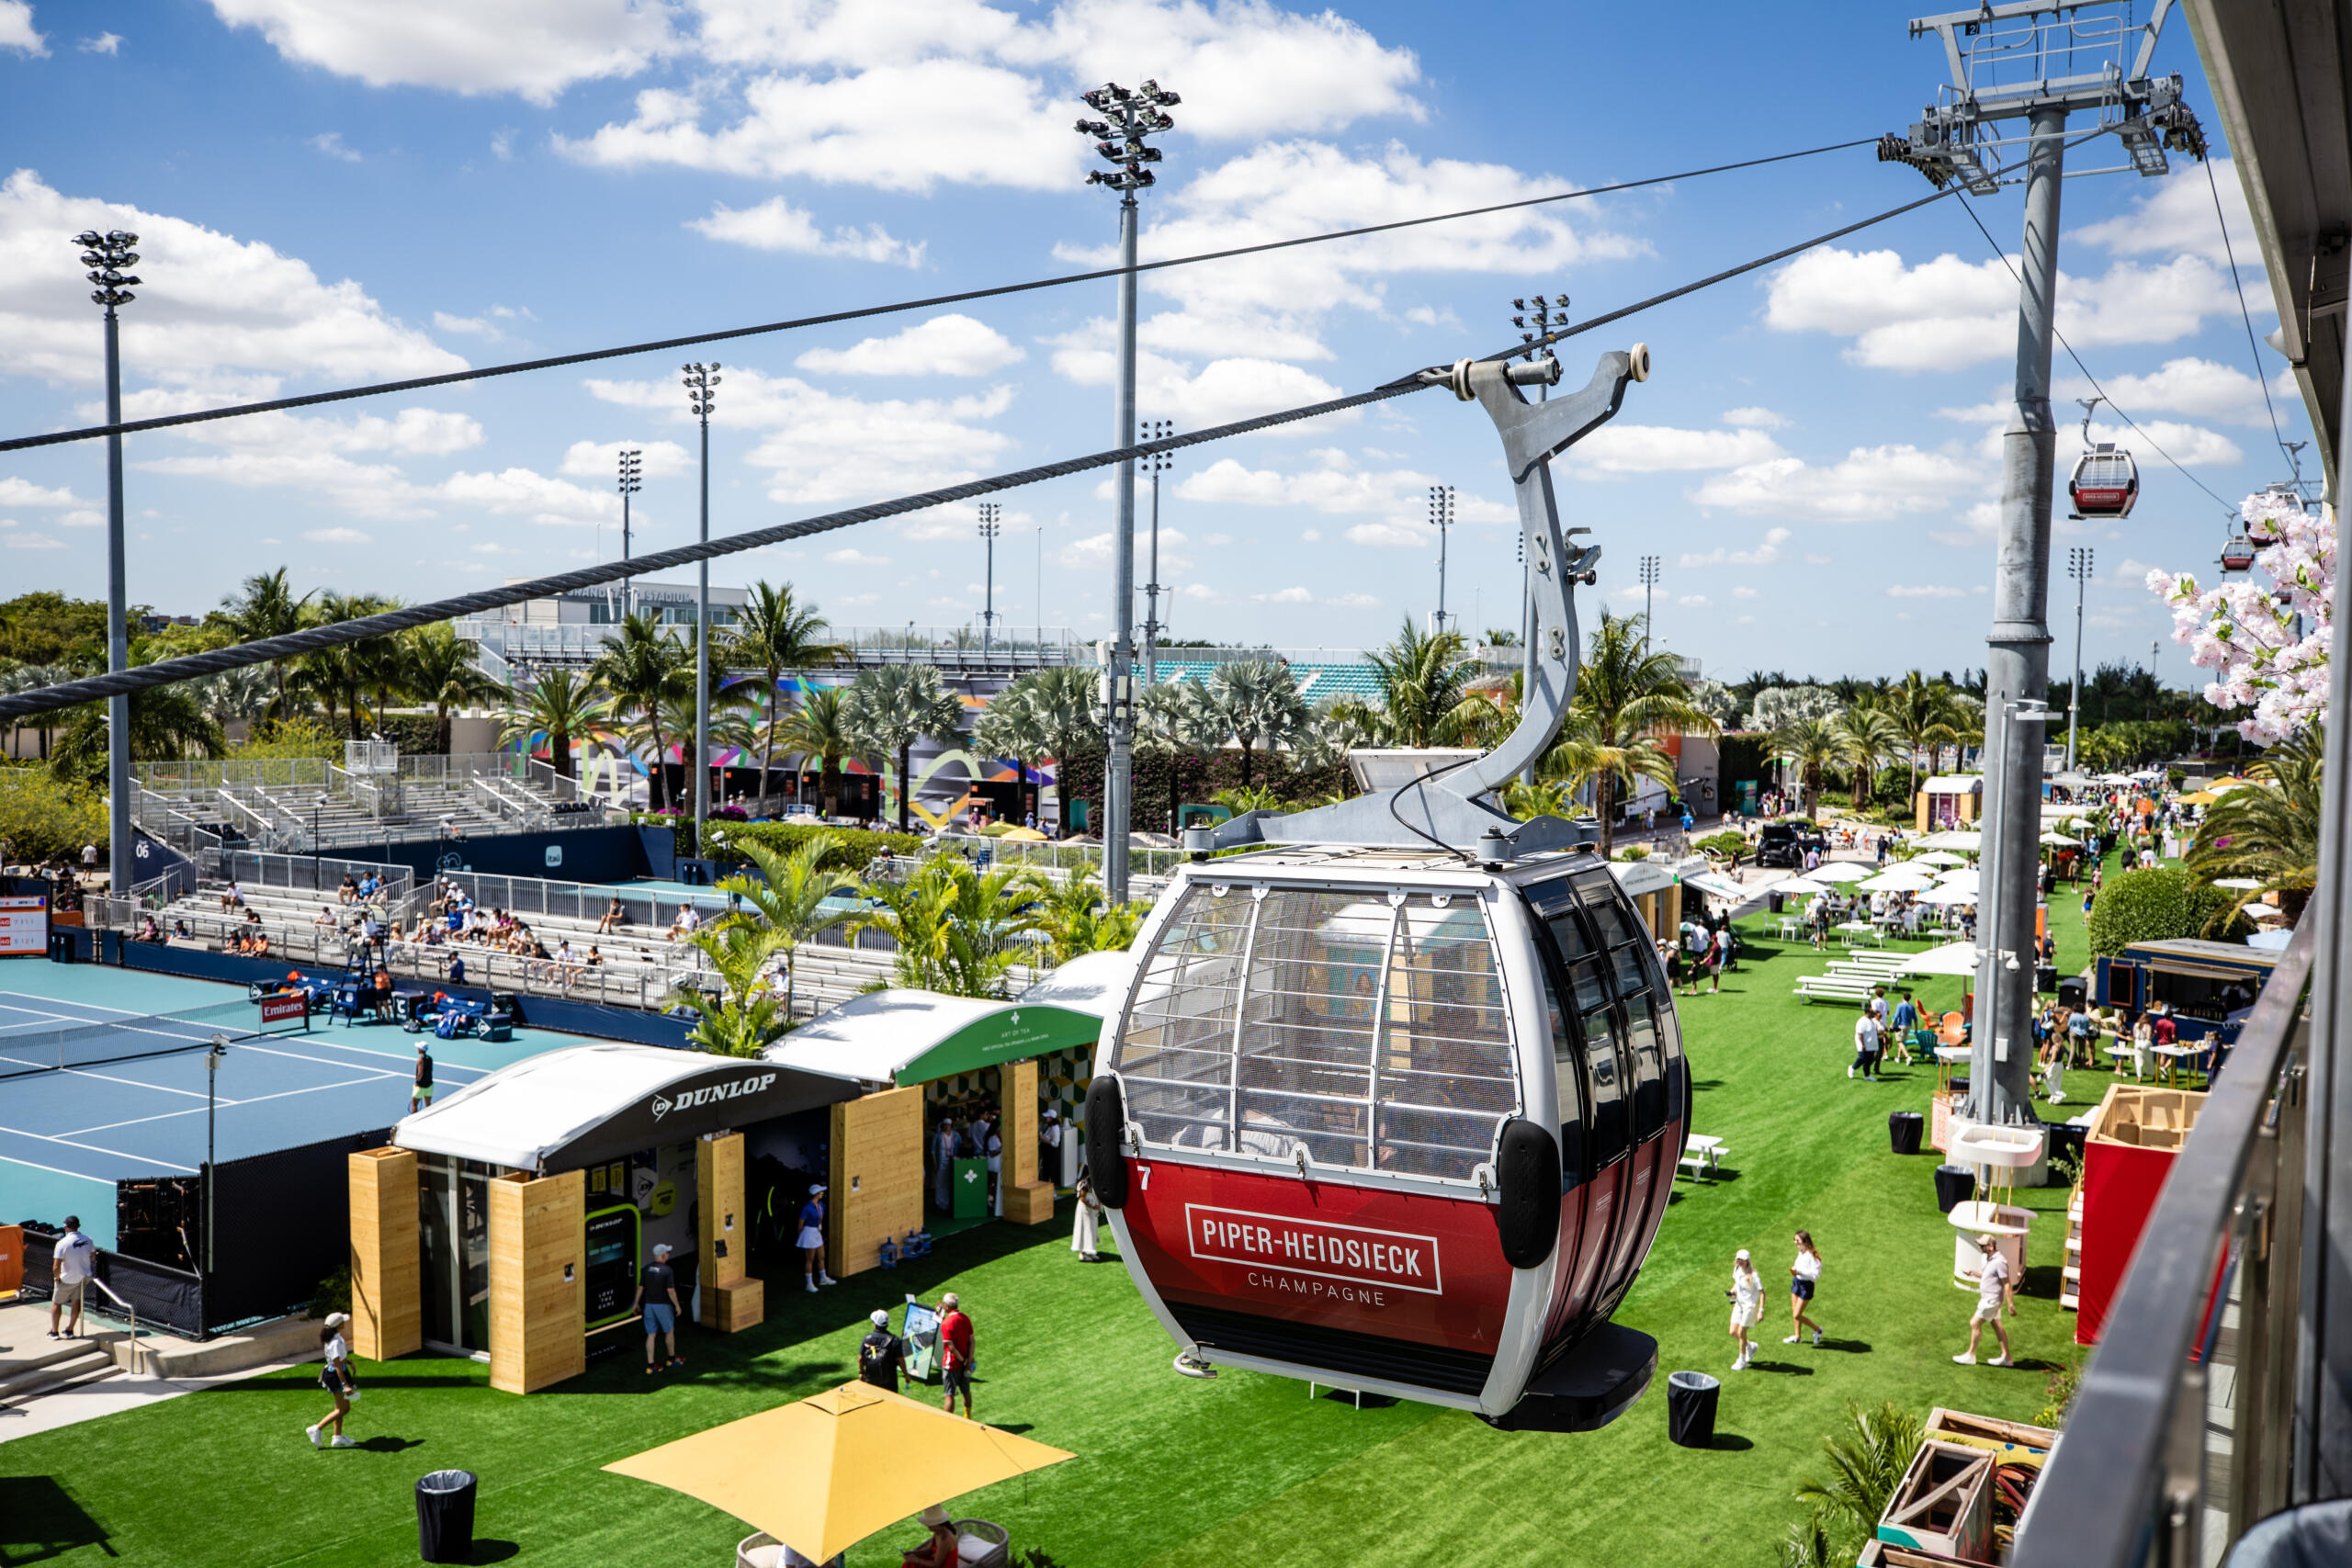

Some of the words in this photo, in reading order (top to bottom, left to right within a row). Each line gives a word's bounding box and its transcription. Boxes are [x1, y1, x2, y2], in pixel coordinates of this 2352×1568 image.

[136, 844, 150, 859] 06
[264, 1002, 303, 1017] Emirates
[673, 1073, 776, 1111] DUNLOP
[1136, 1166, 1151, 1190] 7
[1203, 1219, 1422, 1278] PIPER-HEIDSIECK
[1248, 1272, 1385, 1307] CHAMPAGNE
